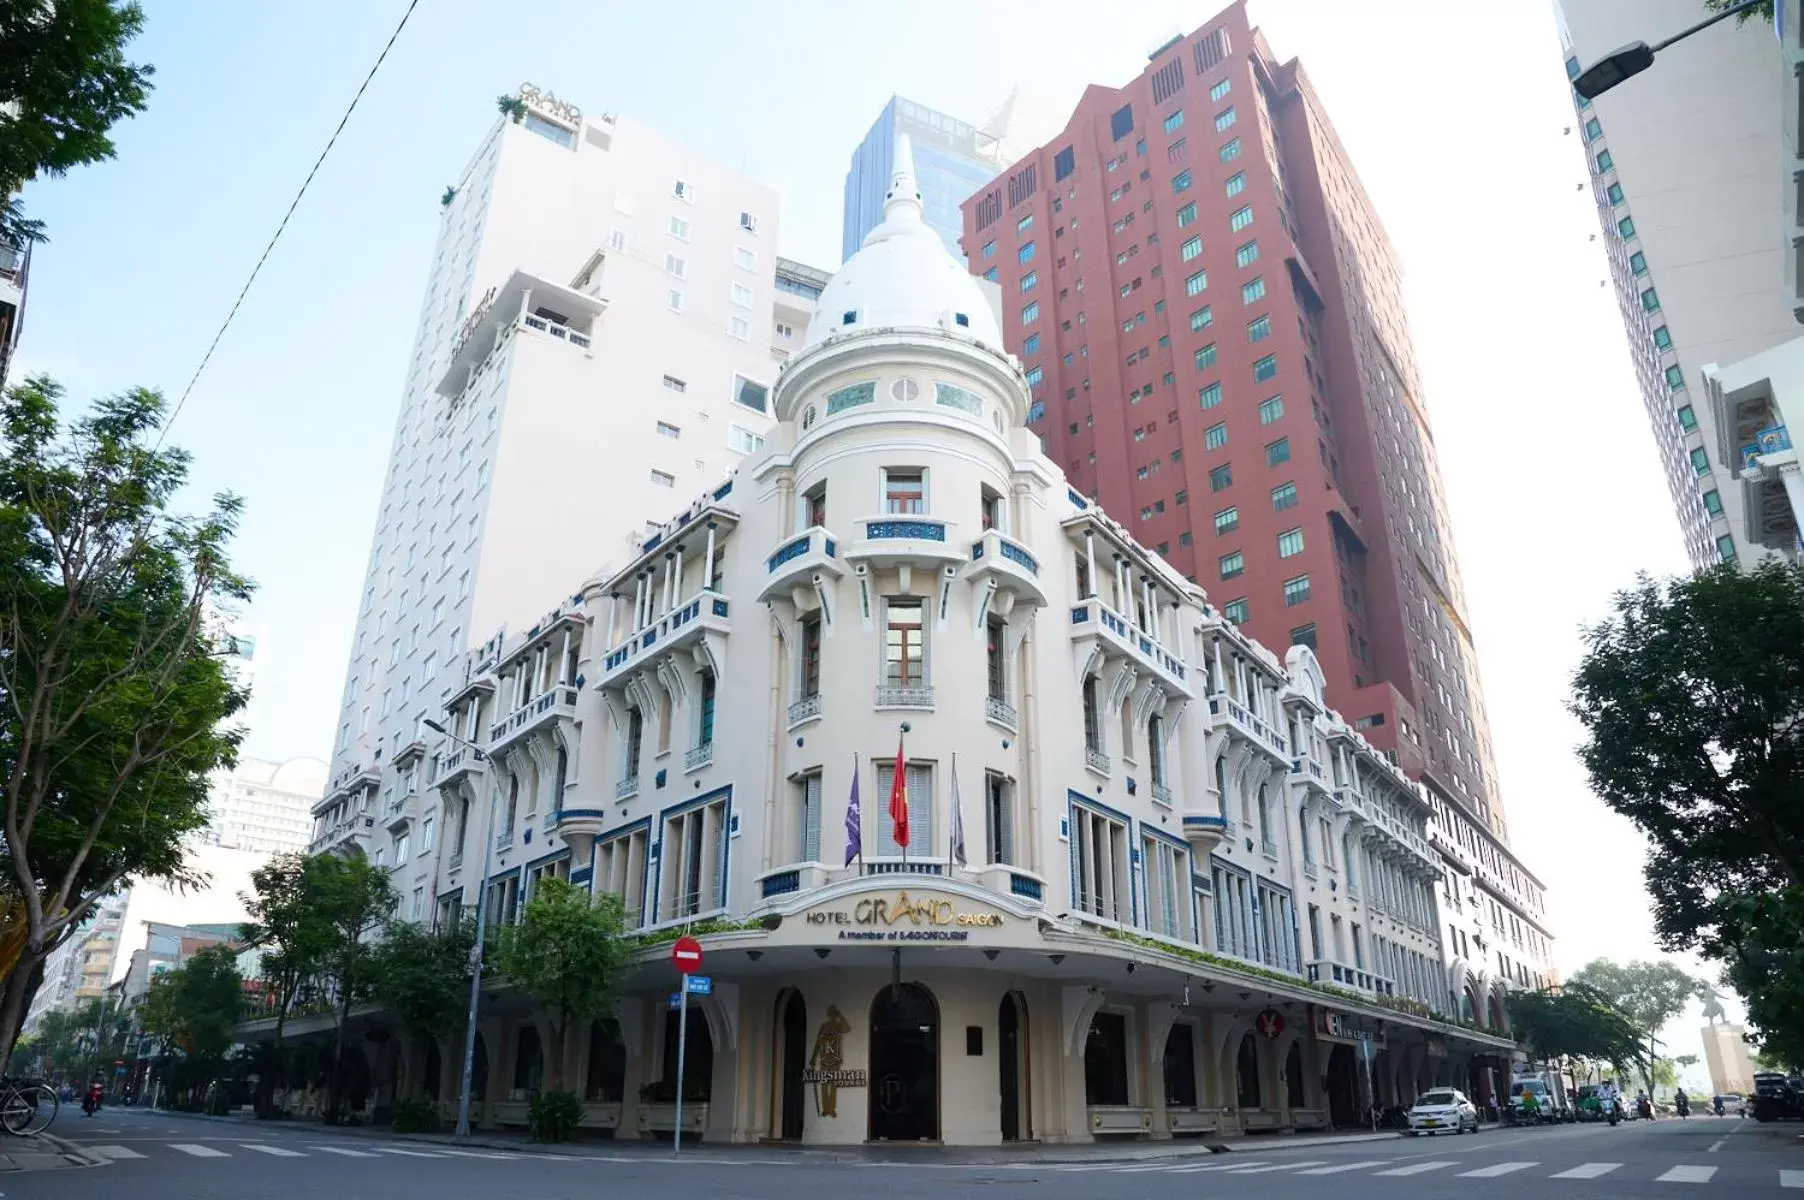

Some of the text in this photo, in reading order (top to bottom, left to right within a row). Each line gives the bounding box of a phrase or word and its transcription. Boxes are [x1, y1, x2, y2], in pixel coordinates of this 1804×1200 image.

[520, 81, 581, 119] GRAND
[806, 888, 1004, 926] HOTEL GRAND SAIGON
[838, 930, 969, 941] A member of SAIGONTOURIST
[826, 1039, 835, 1054] K
[802, 1068, 866, 1084] Kingsman
